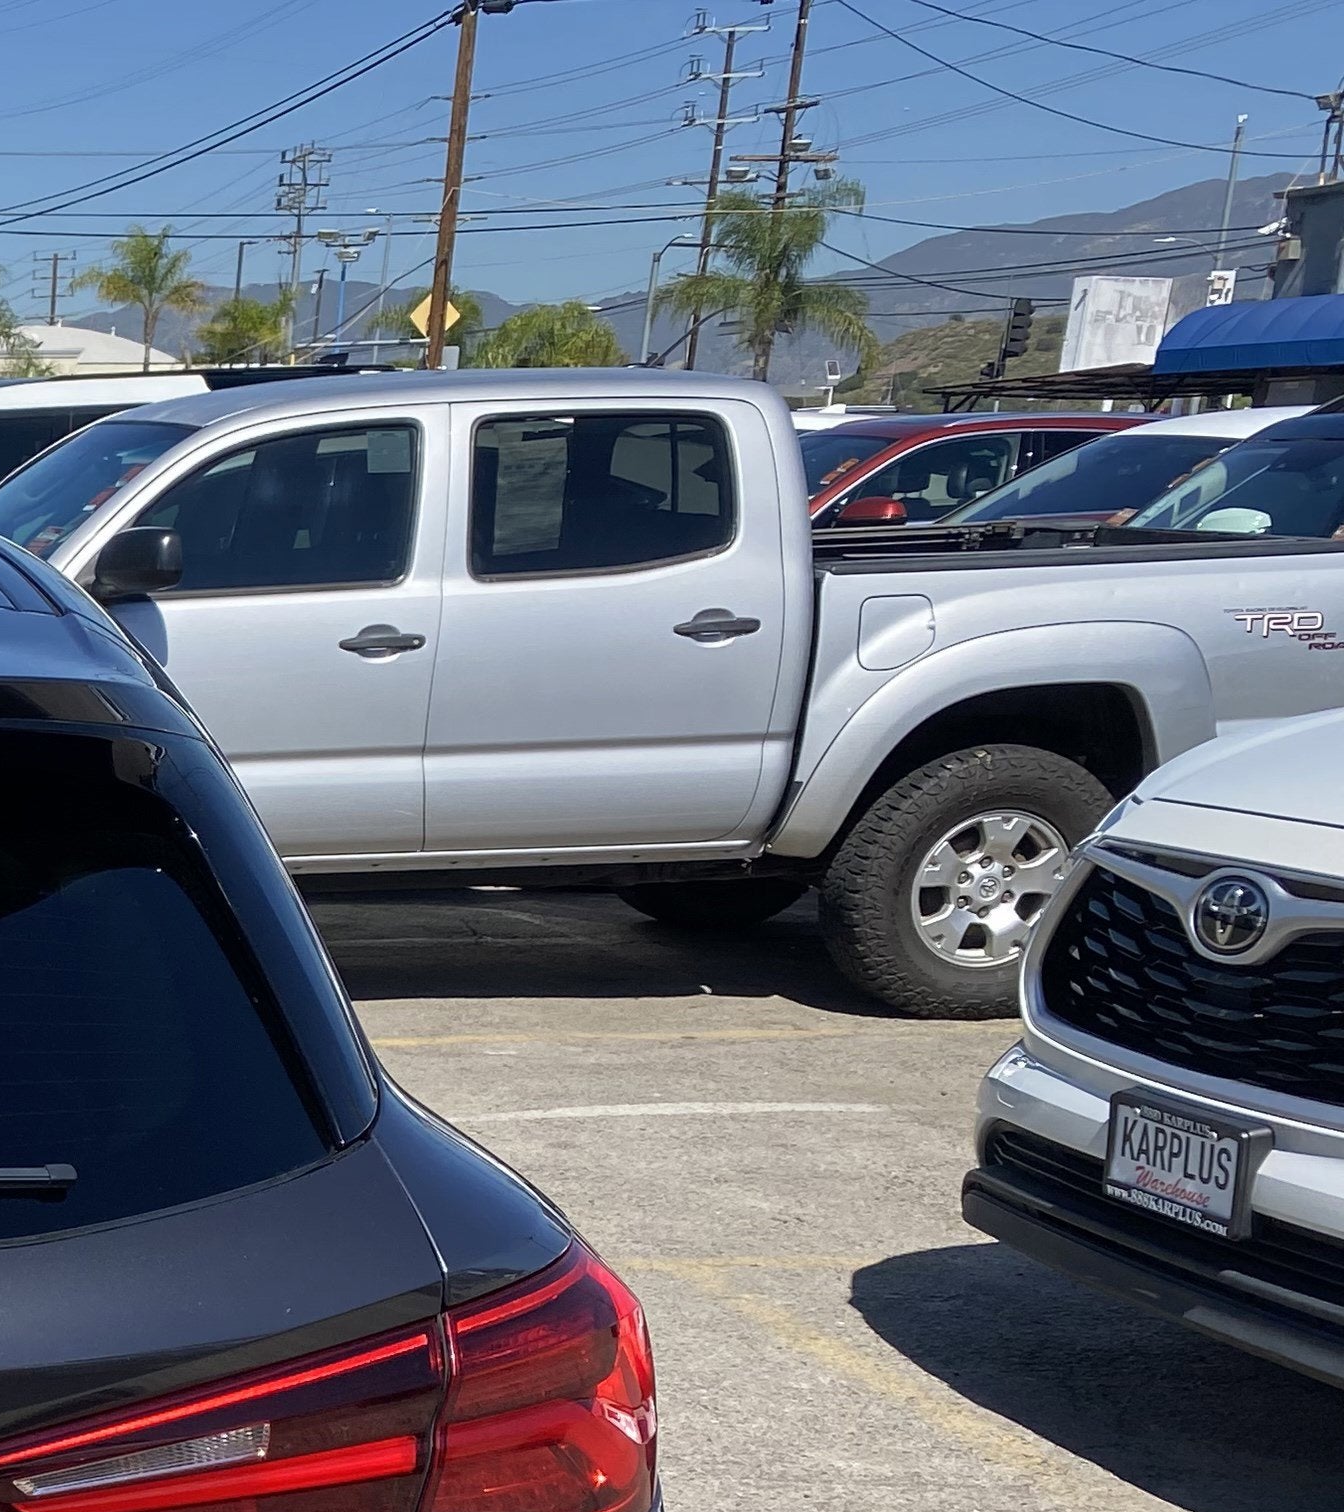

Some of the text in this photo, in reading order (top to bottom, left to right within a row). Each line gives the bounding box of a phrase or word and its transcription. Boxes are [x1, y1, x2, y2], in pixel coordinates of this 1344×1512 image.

[1234, 611, 1324, 638] TRD
[1297, 632, 1337, 641] OFF
[1162, 1112, 1213, 1137] KARPLUS
[1120, 1116, 1233, 1191] KARPLUS
[1135, 1165, 1211, 1208] Warehouse
